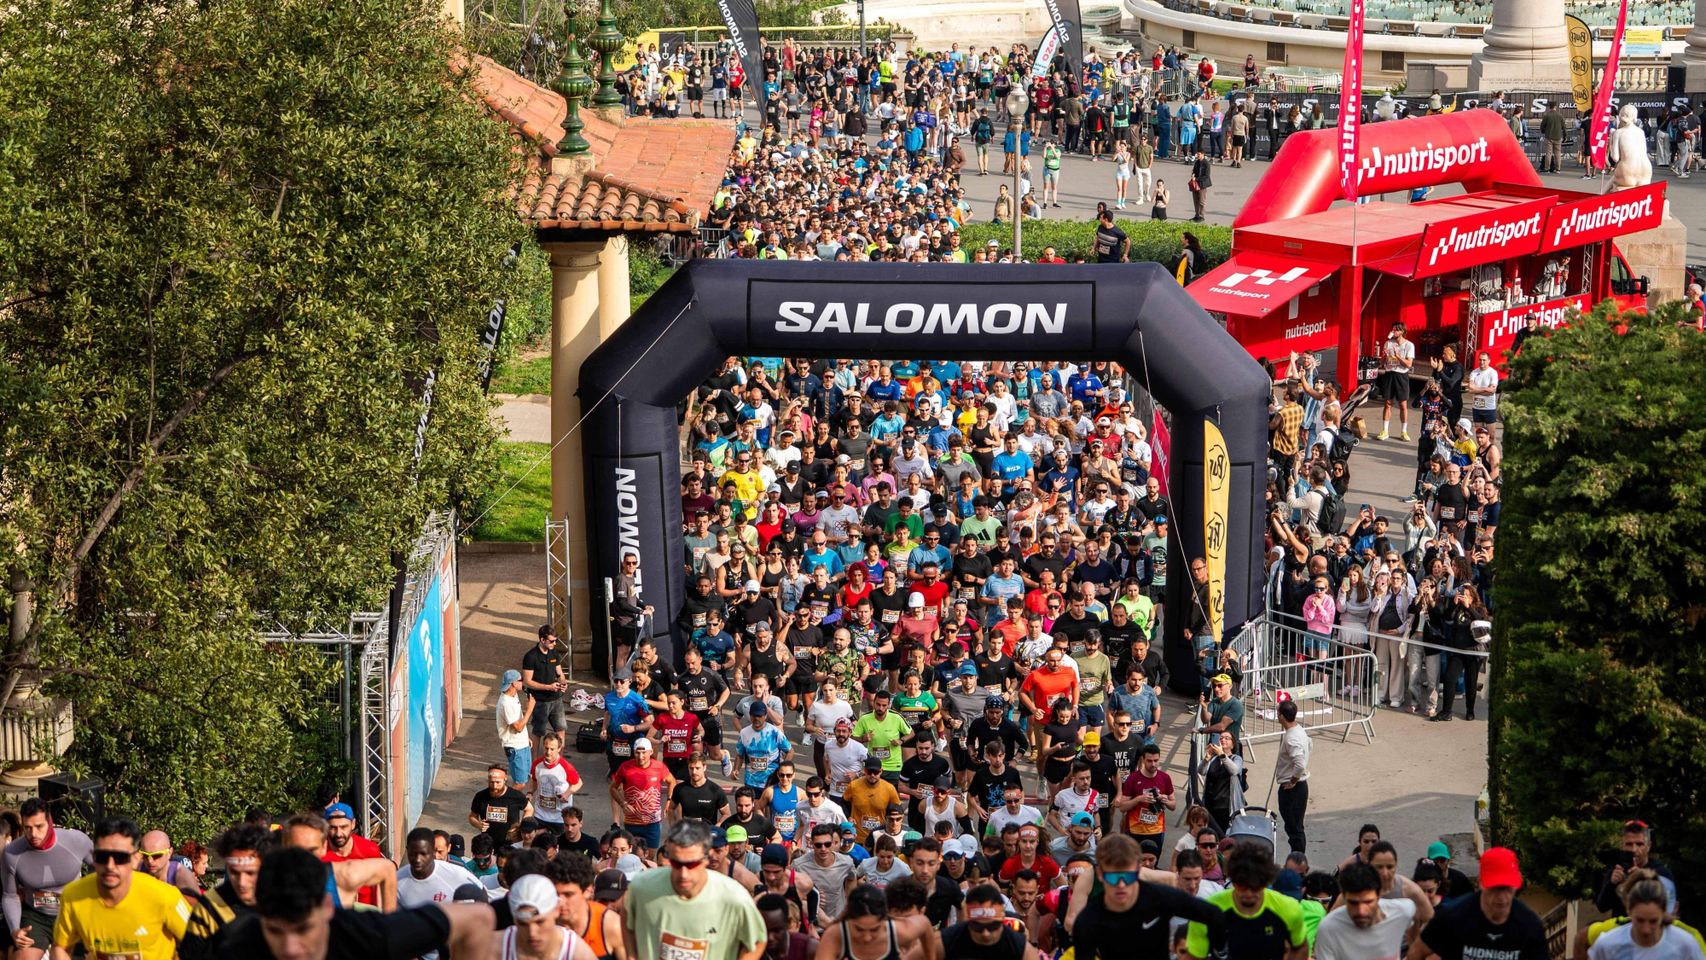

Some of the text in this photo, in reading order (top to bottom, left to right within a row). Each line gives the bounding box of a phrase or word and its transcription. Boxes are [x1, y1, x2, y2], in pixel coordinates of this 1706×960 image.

[1382, 137, 1488, 176] nutrisport
[1575, 194, 1650, 233] nutrisport
[1454, 212, 1540, 252] nutrisport
[1209, 287, 1270, 299] nutrisport
[775, 301, 1067, 334] SALOMON
[1285, 319, 1327, 339] nutrisport
[1115, 751, 1128, 760] WE
[1463, 945, 1521, 960] MIDNIGHT
